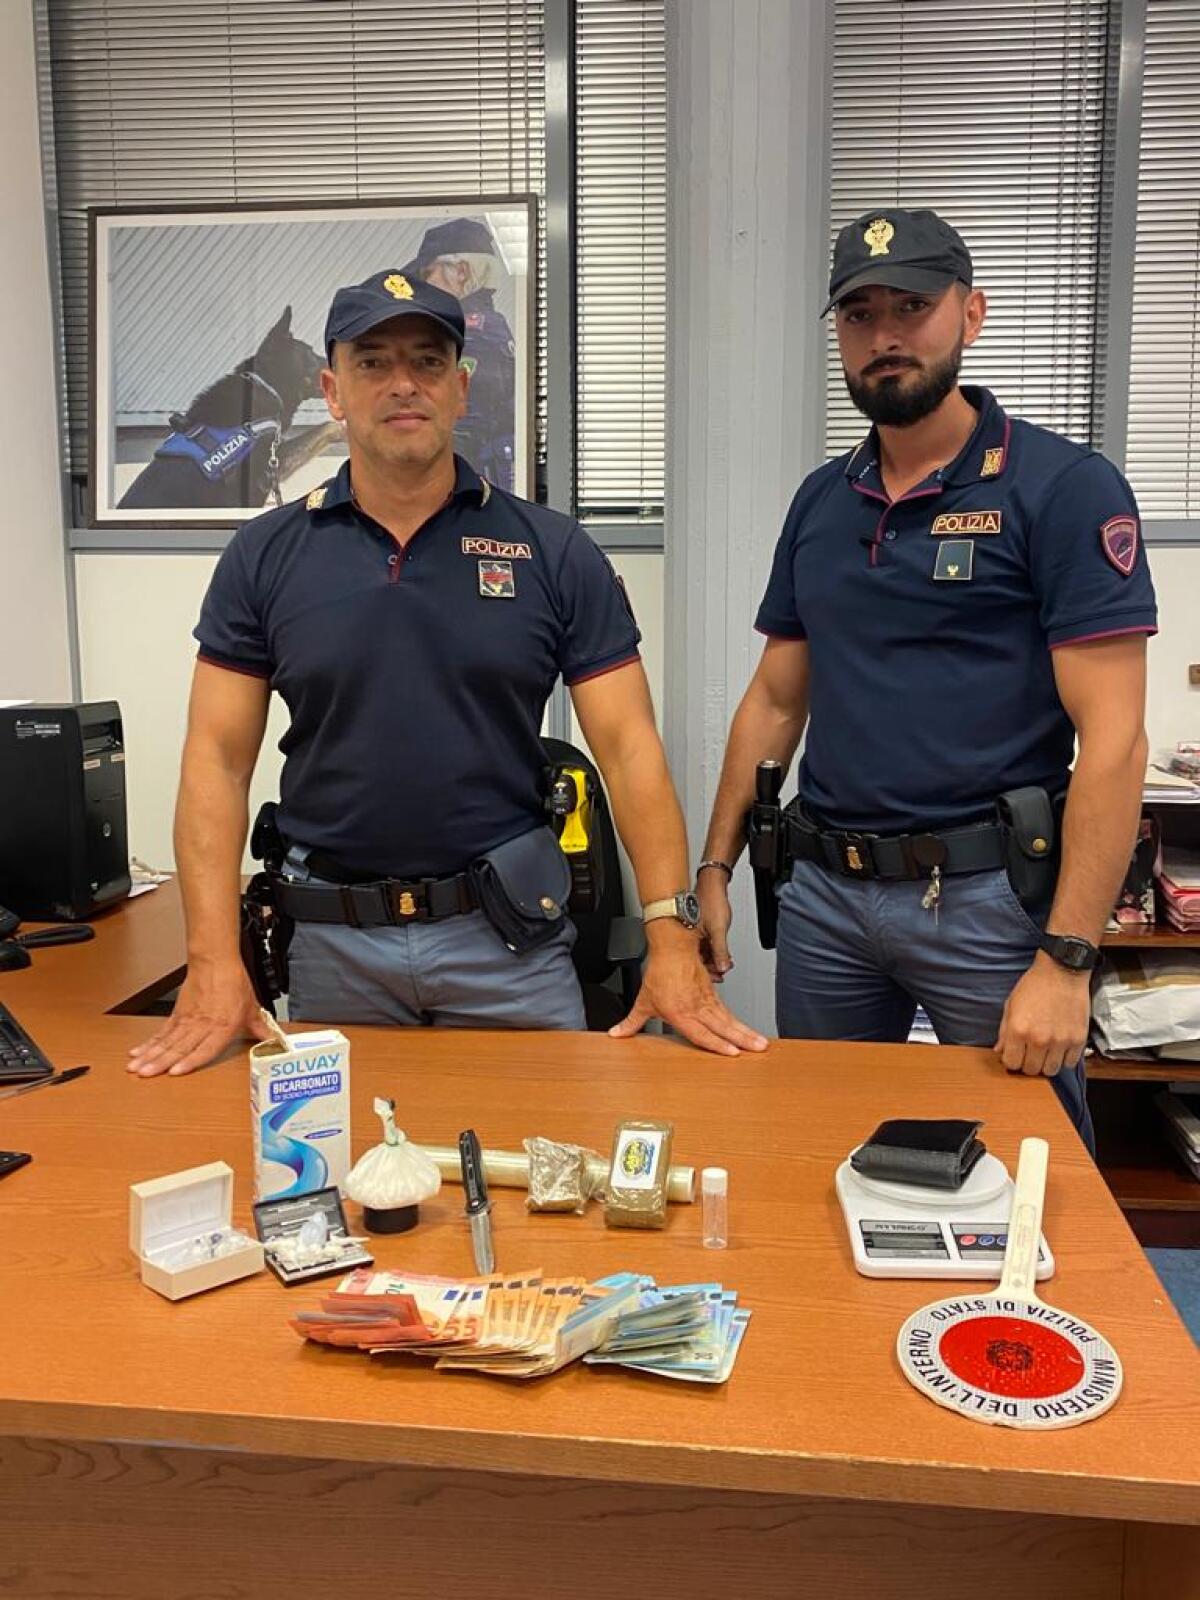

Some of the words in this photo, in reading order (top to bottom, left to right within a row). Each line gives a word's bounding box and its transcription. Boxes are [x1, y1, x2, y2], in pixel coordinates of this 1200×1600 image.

[203, 434, 248, 472] POLIZIA
[936, 513, 998, 531] POLIZIA
[464, 539, 528, 557] POLIZIA
[271, 1053, 339, 1077] SOLVAY
[273, 1074, 338, 1095] BICARBONATO
[930, 1299, 987, 1322] STATO
[996, 1301, 1015, 1311] DI
[1027, 1304, 1096, 1343] POLIZIA
[909, 1328, 1019, 1417] DELL'INTERNO
[1033, 1358, 1116, 1419] MINISTERO
